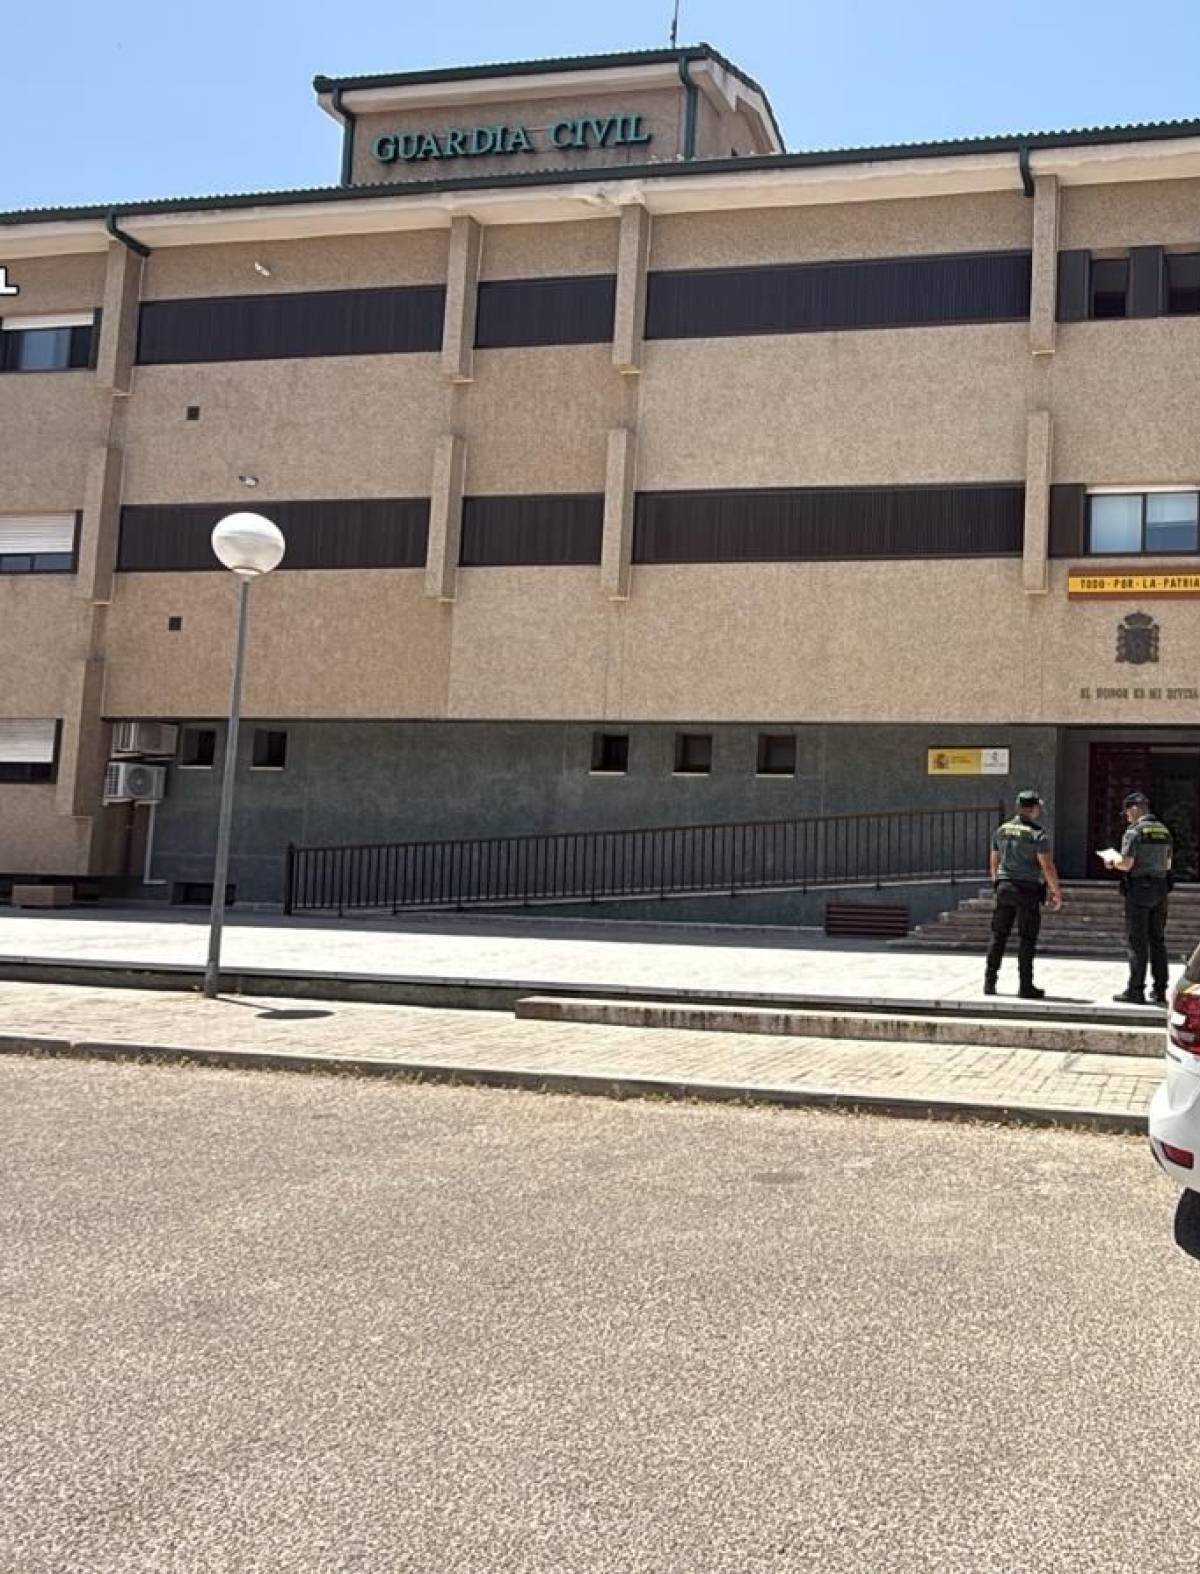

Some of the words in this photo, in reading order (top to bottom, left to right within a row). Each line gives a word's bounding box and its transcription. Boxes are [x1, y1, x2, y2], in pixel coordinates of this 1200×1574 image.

[374, 127, 532, 162] GUARDIA
[549, 113, 652, 149] CIVIL
[1080, 578, 1105, 589] TODO
[1143, 578, 1156, 589] LA
[1163, 577, 1200, 588] PATRIA
